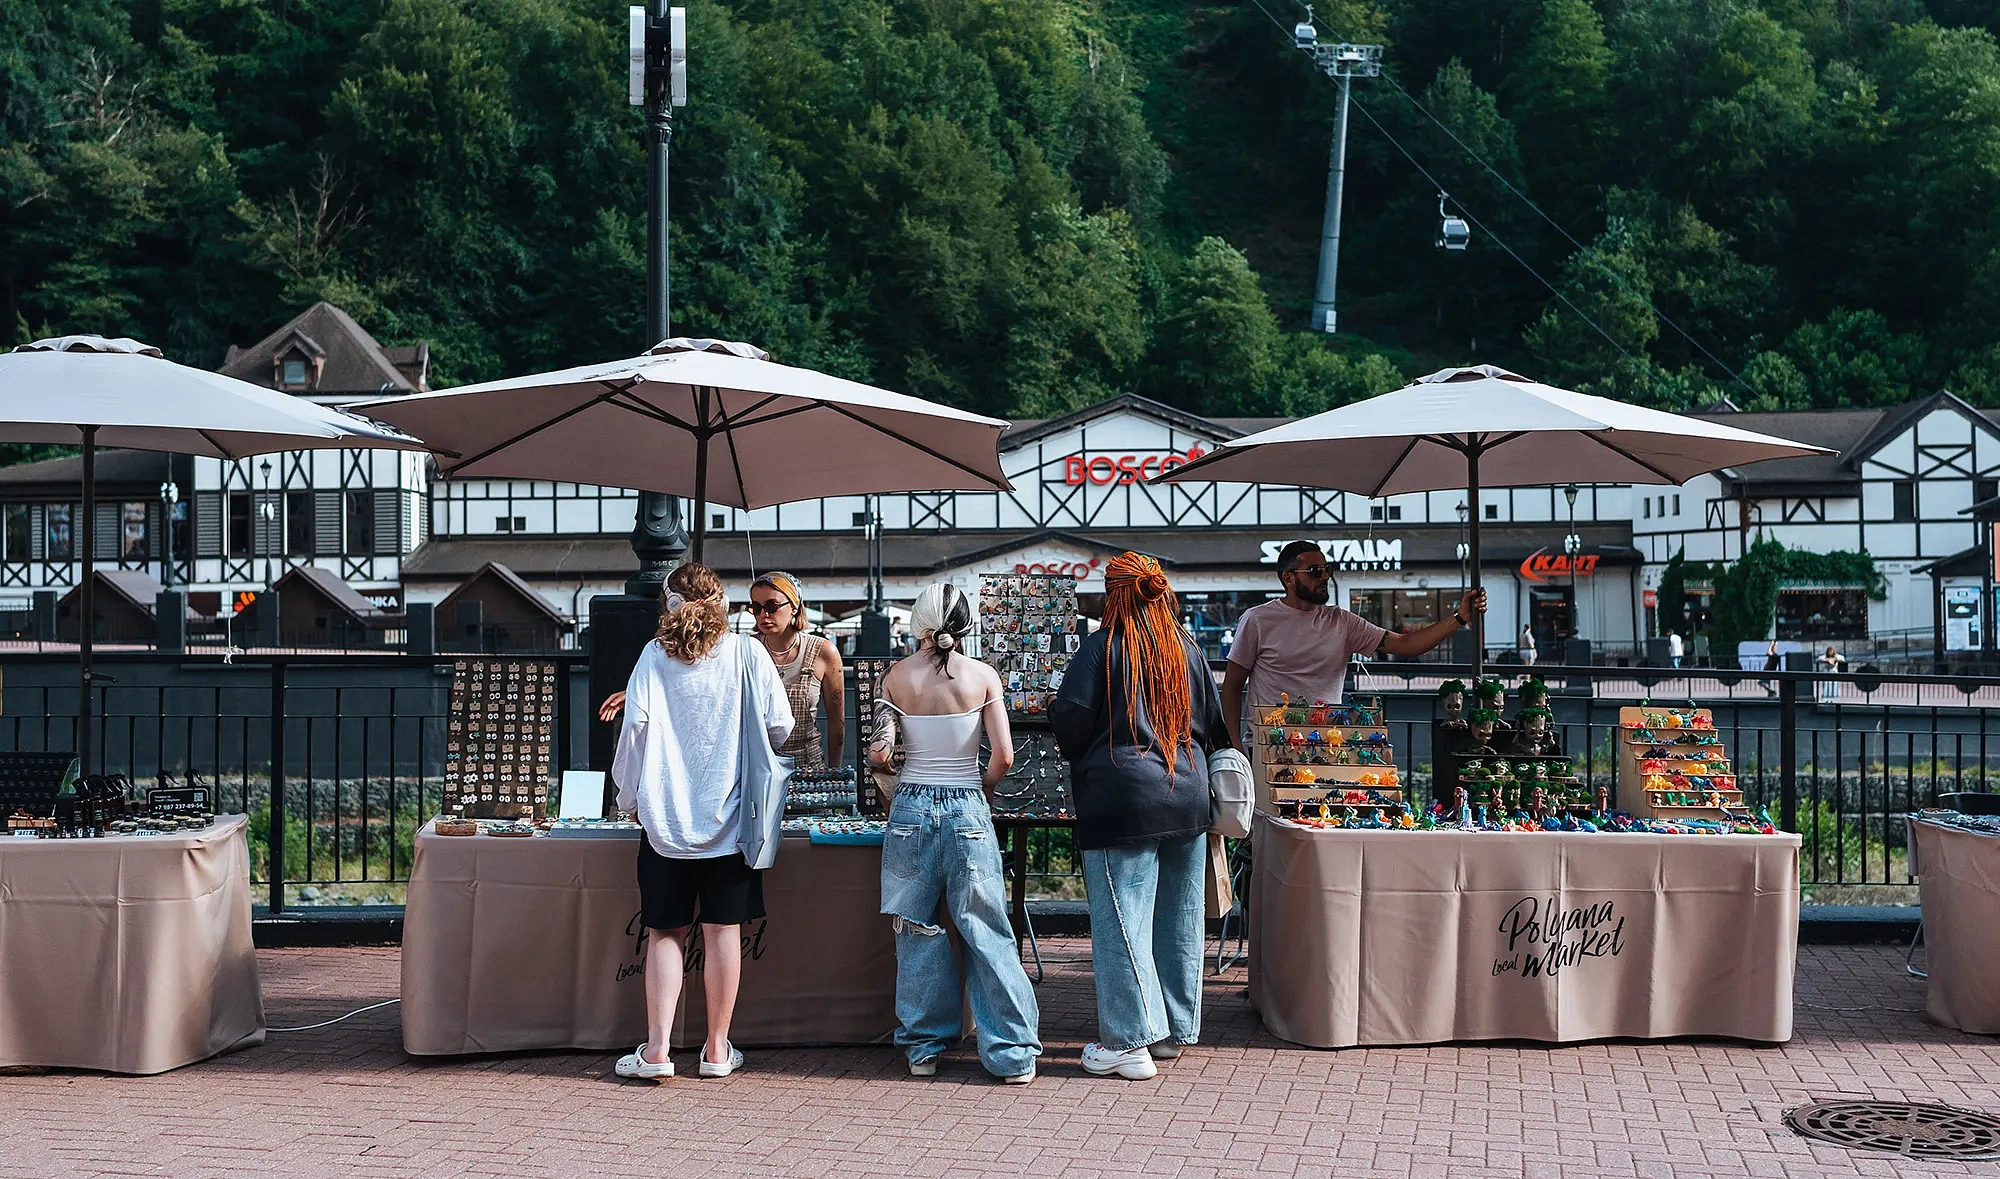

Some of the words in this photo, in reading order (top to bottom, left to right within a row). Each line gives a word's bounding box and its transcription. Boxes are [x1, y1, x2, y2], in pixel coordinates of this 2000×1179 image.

[1064, 455, 1187, 486] BOSCO
[1014, 563, 1090, 580] BOSCO
[1339, 562, 1402, 572] KHUTOR
[1498, 896, 1614, 952] Polyana
[1491, 952, 1519, 976] Local
